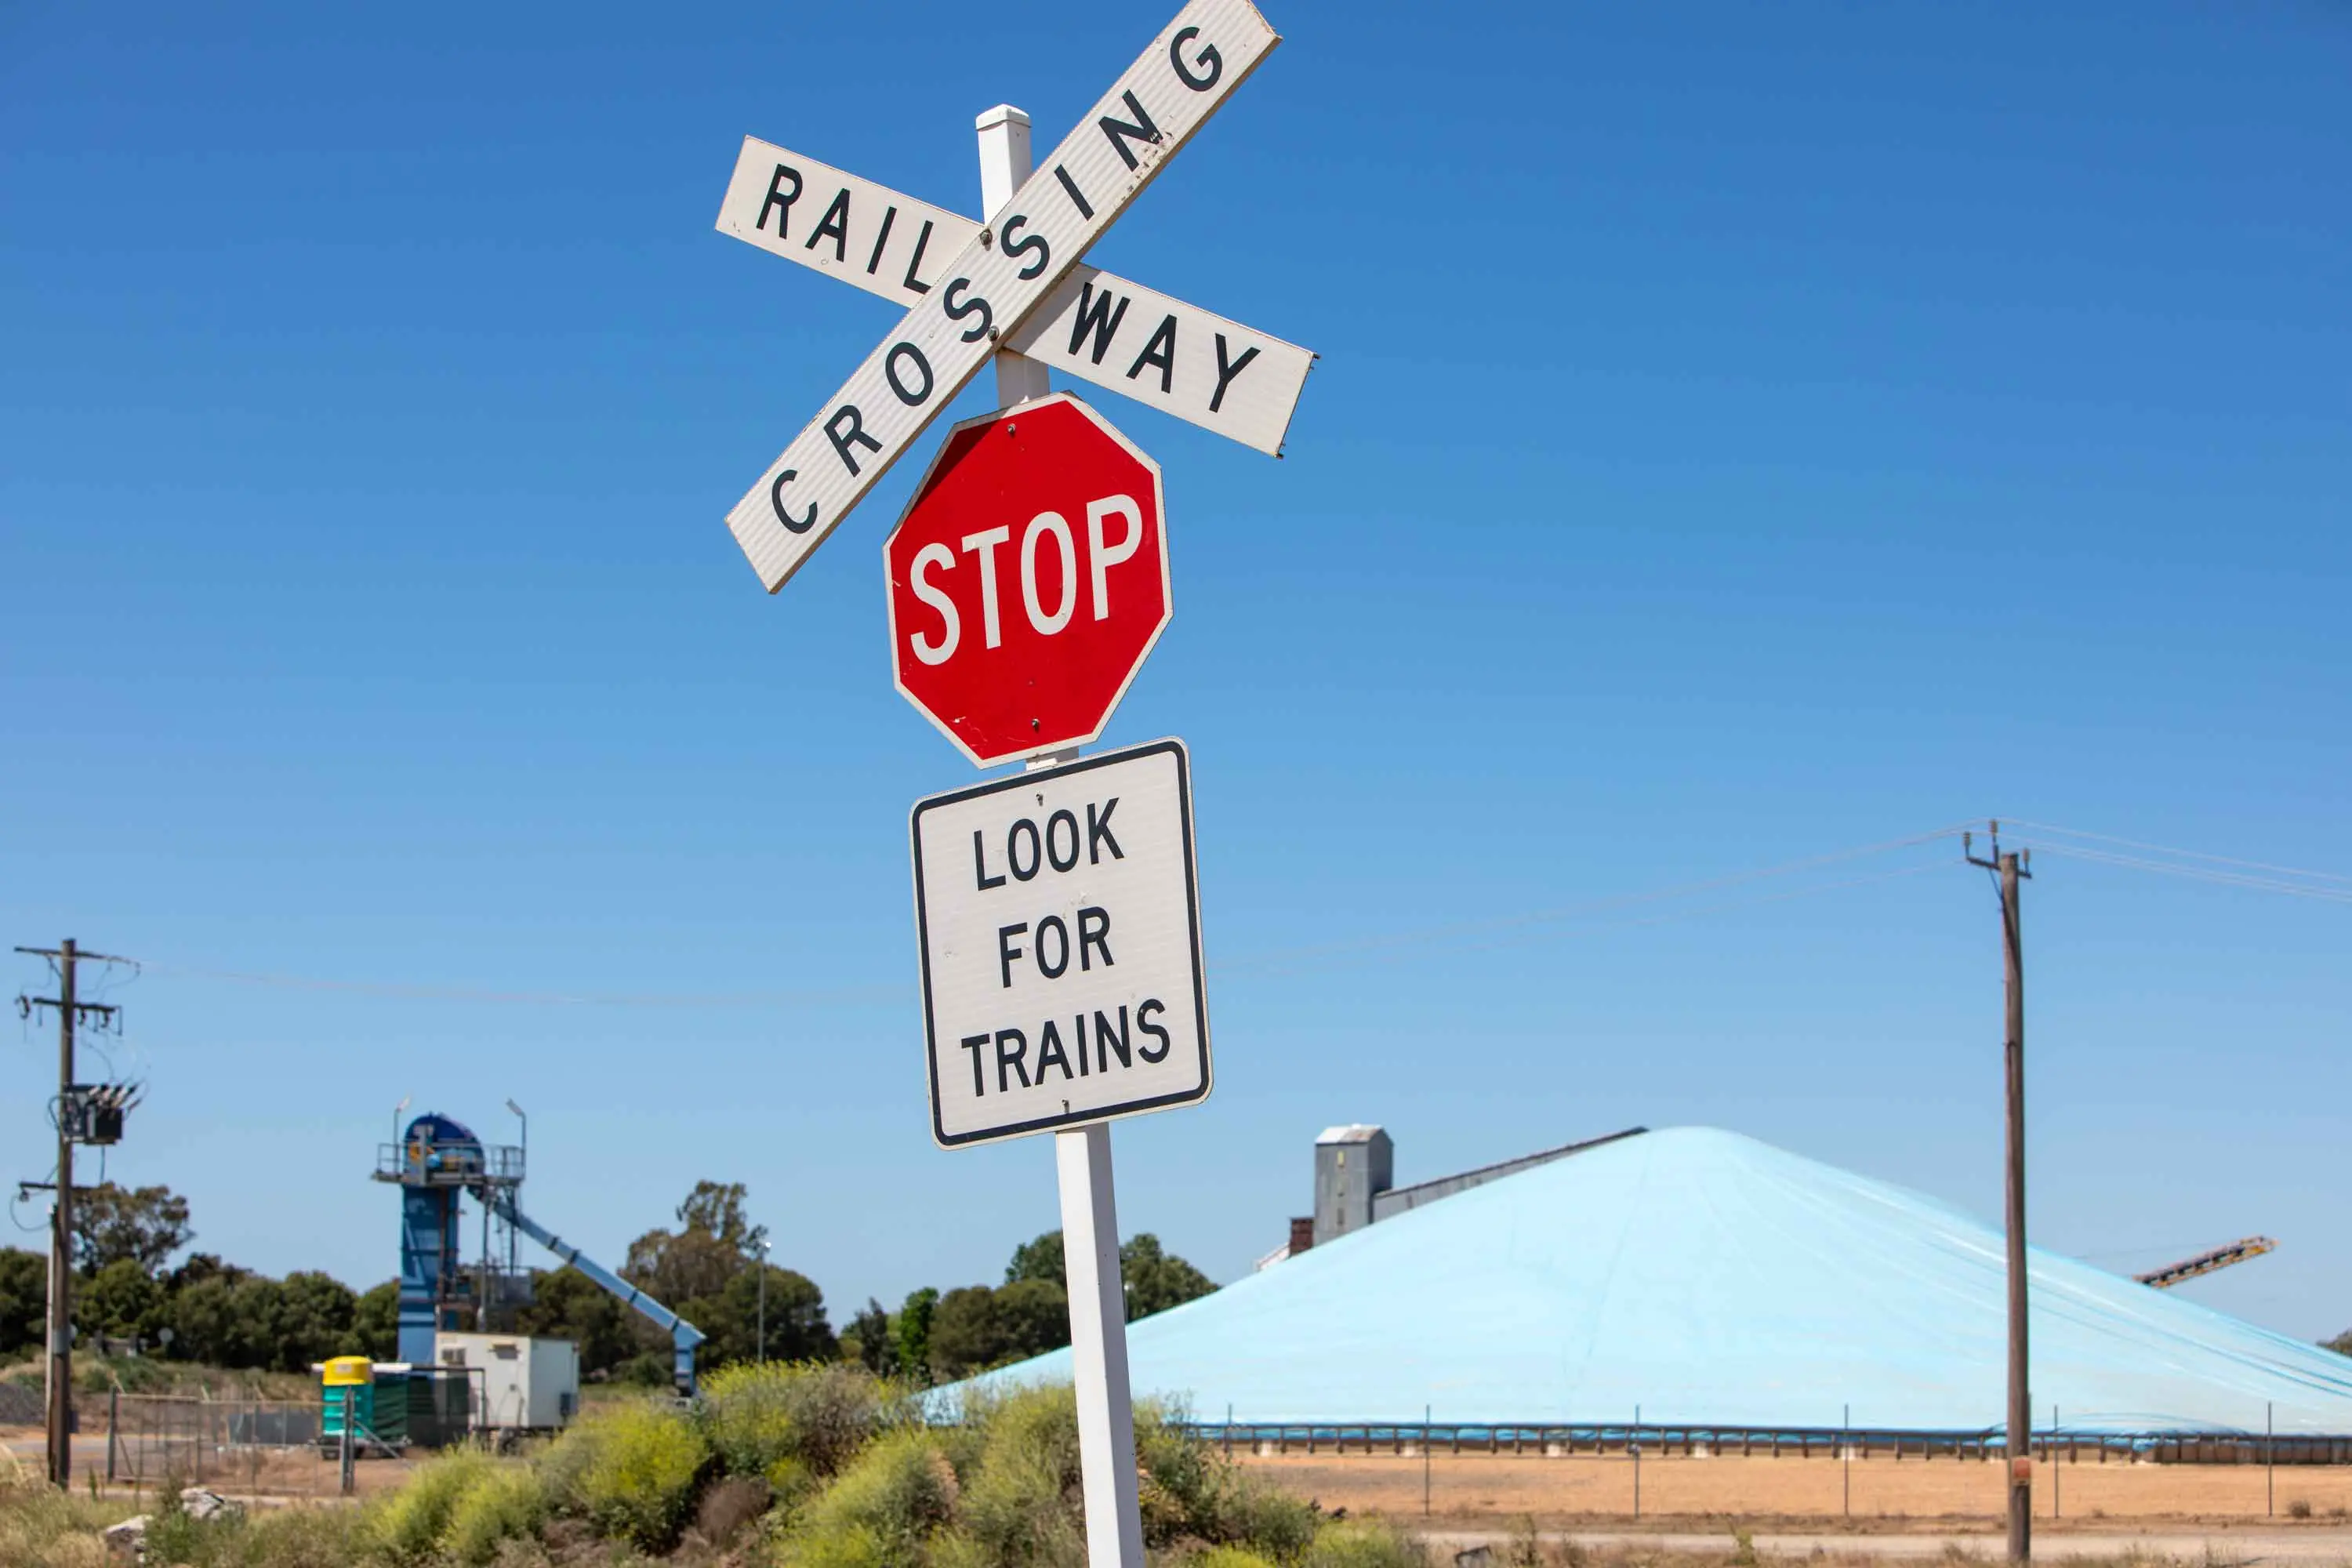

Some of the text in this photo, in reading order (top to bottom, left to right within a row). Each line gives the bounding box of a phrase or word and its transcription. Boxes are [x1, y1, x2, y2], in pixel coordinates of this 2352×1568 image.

[756, 163, 1261, 413] RAIL WAY
[771, 27, 1223, 535] CROSSING
[909, 494, 1144, 666] STOP
[974, 797, 1124, 891] LOOK
[999, 906, 1115, 989] FOR
[960, 998, 1171, 1098] TRAINS
